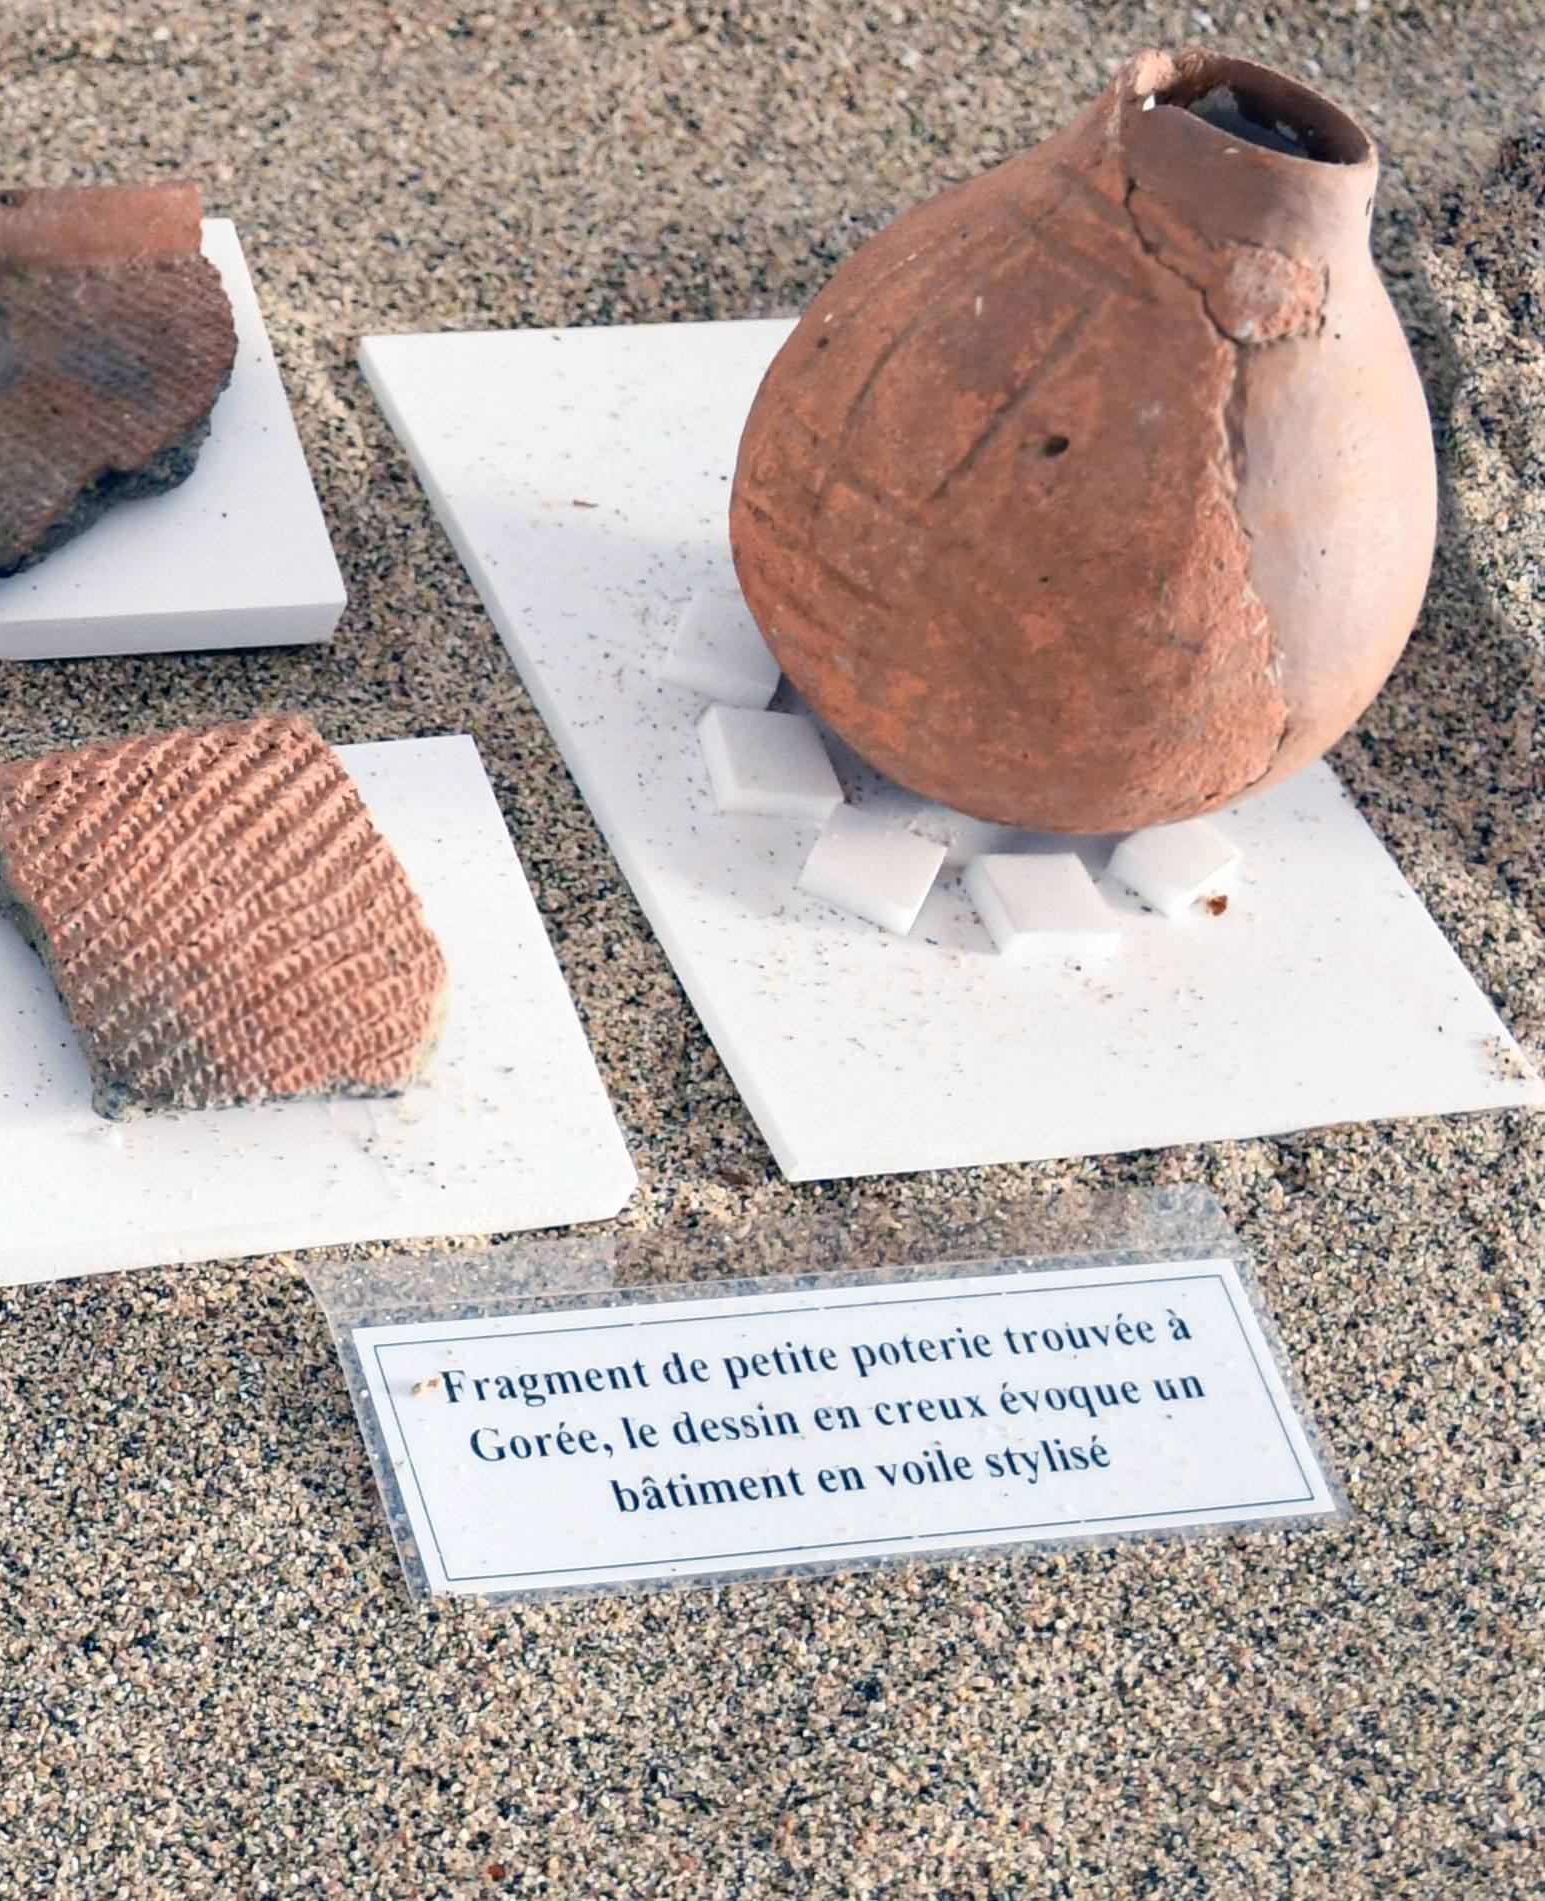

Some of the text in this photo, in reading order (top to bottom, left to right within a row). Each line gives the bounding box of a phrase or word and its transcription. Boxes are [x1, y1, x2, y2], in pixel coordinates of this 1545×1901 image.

[442, 1309, 1192, 1406] Fragment de petite poterie trouvée à
[471, 1376, 1204, 1462] Gorée, le dessin en creux évoque un
[611, 1435, 1110, 1512] bâtiment en voile stylisé
